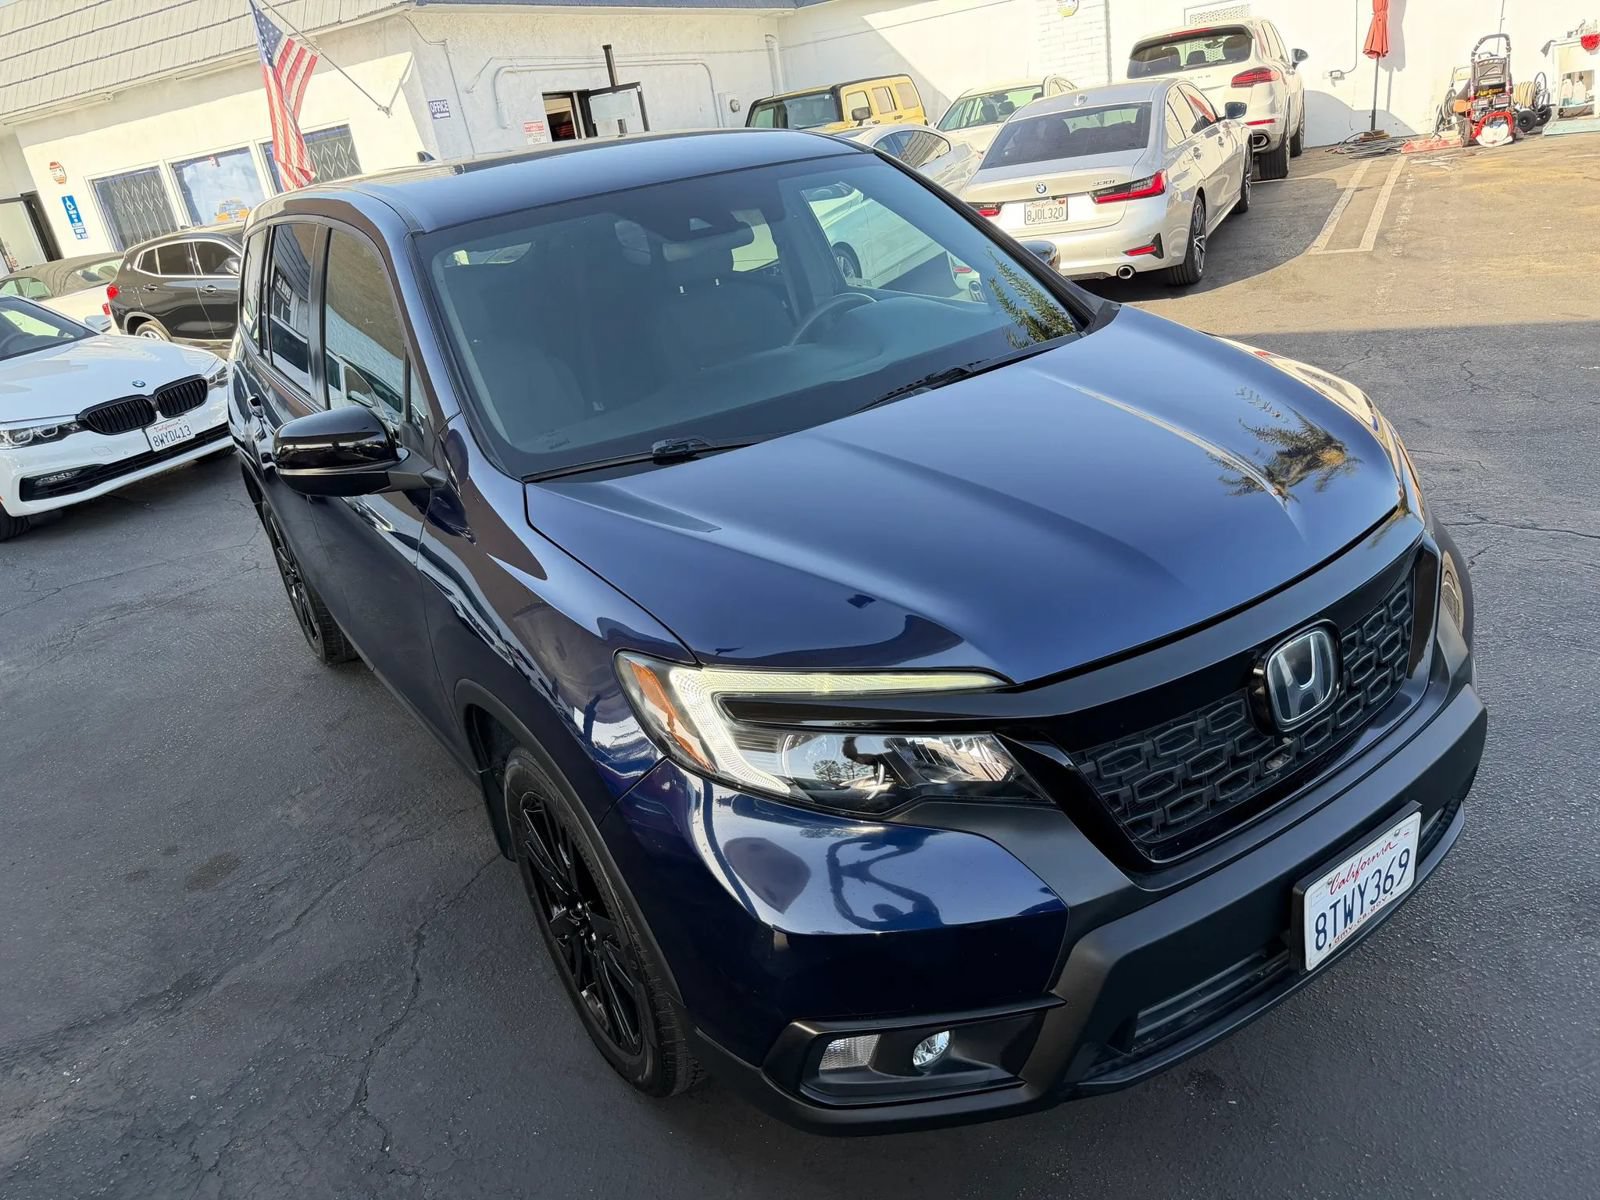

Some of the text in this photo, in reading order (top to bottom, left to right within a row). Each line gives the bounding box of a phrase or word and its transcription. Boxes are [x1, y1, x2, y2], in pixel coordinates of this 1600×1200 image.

[430, 100, 450, 112] OFFICE
[1026, 206, 1064, 222] 8JDL320
[152, 424, 192, 447] 8WYD413
[1329, 840, 1398, 896] California
[1314, 847, 1410, 951] 8TWY369
[1333, 896, 1388, 945] dmv.ca.gov
